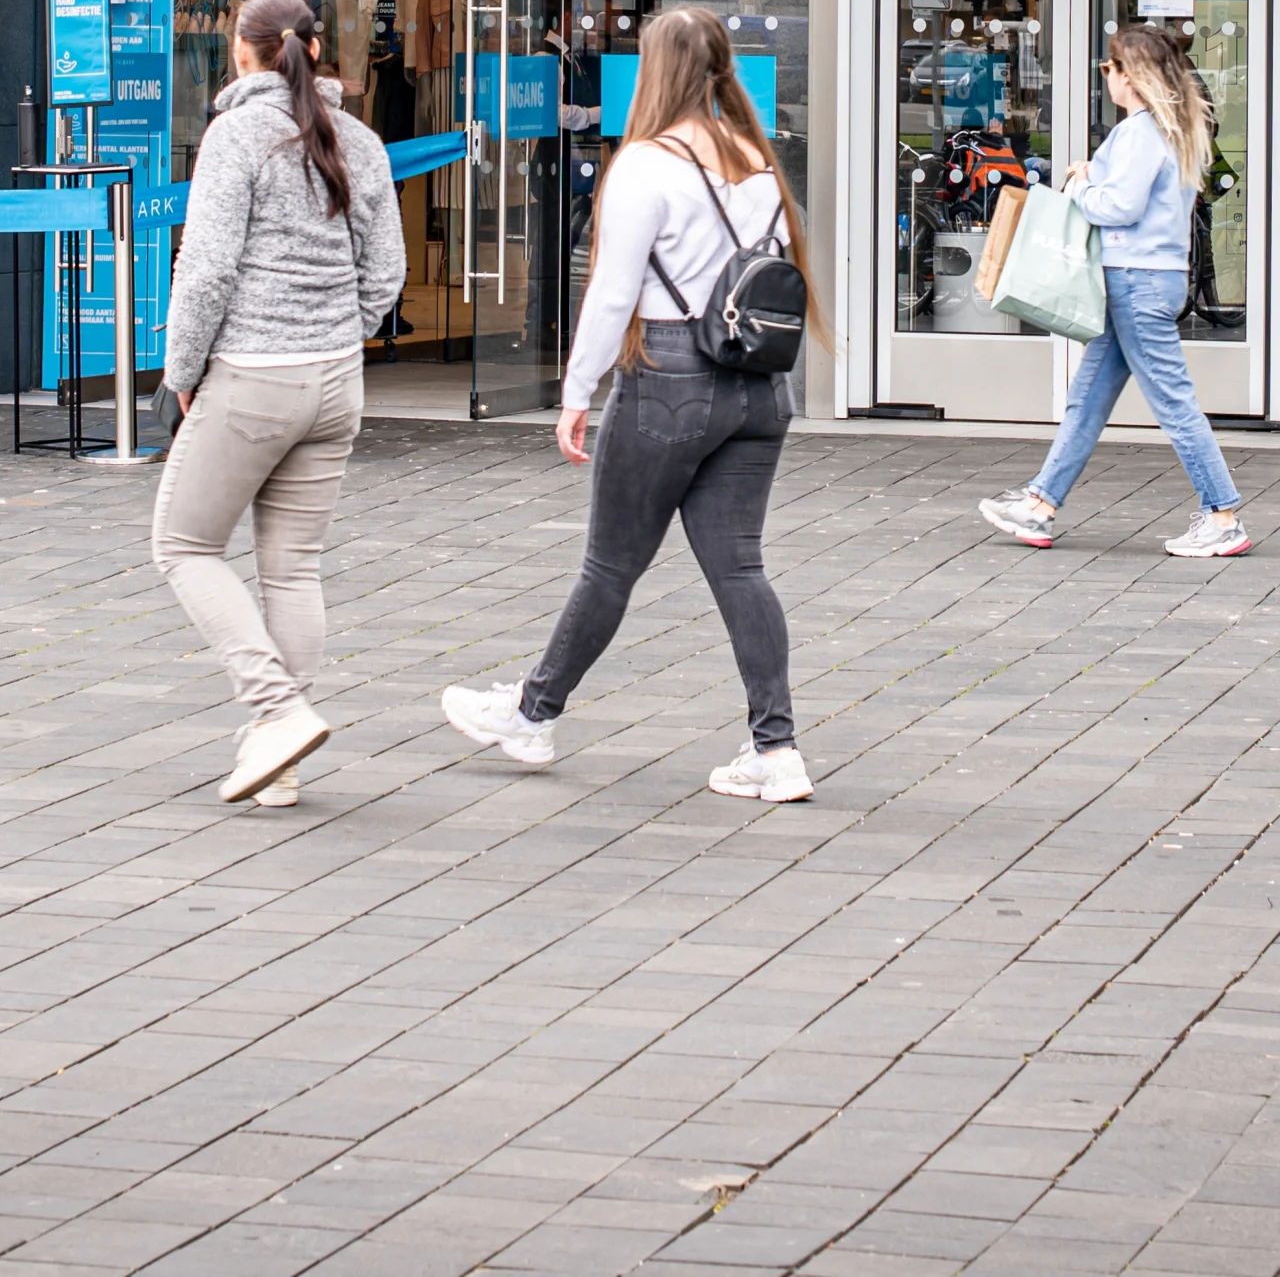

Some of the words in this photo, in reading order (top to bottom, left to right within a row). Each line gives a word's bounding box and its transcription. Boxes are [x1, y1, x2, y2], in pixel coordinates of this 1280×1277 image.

[55, 5, 102, 17] DESINFECTIE
[117, 79, 161, 101] UITGANG
[120, 145, 149, 153] KLANTEN
